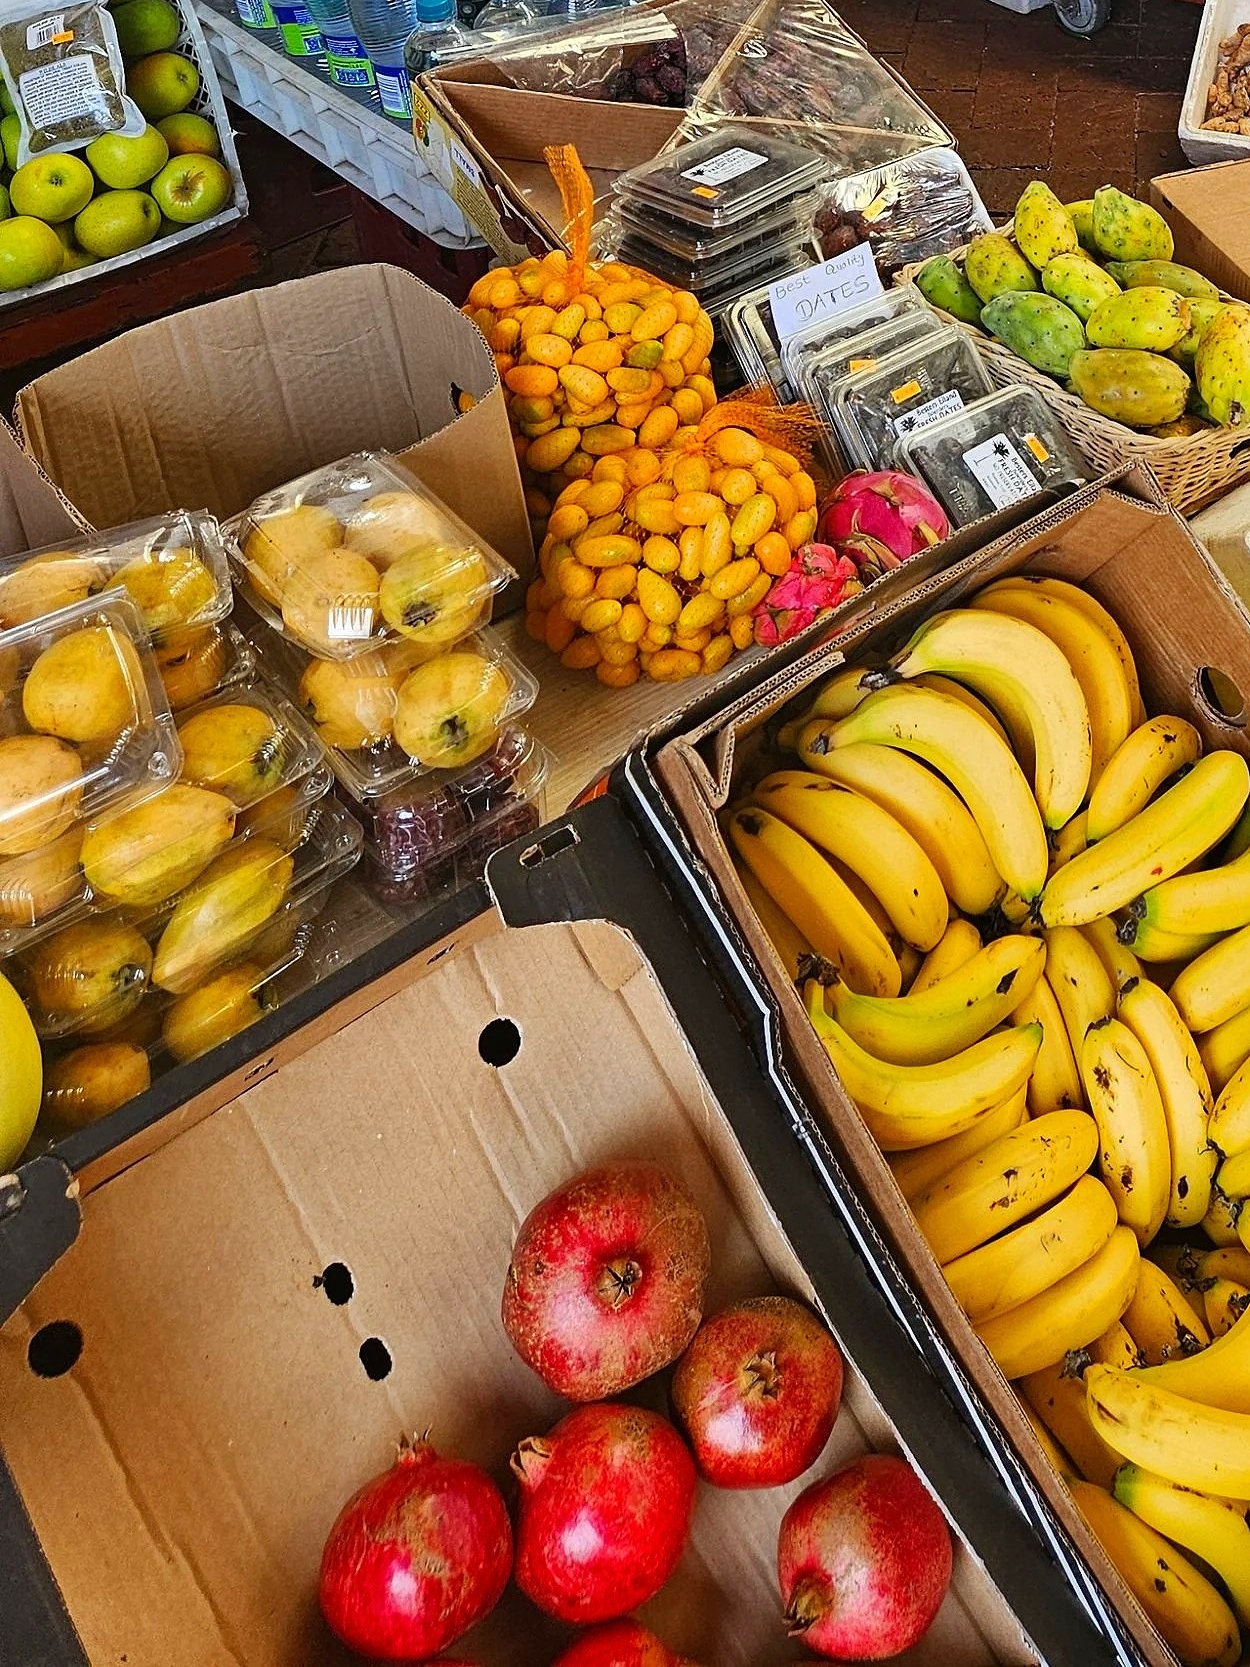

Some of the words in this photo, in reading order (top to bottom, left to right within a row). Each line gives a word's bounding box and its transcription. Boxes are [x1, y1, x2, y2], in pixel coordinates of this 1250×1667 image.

[775, 275, 811, 300] Best
[825, 253, 865, 276] Quality
[795, 274, 870, 322] DATES
